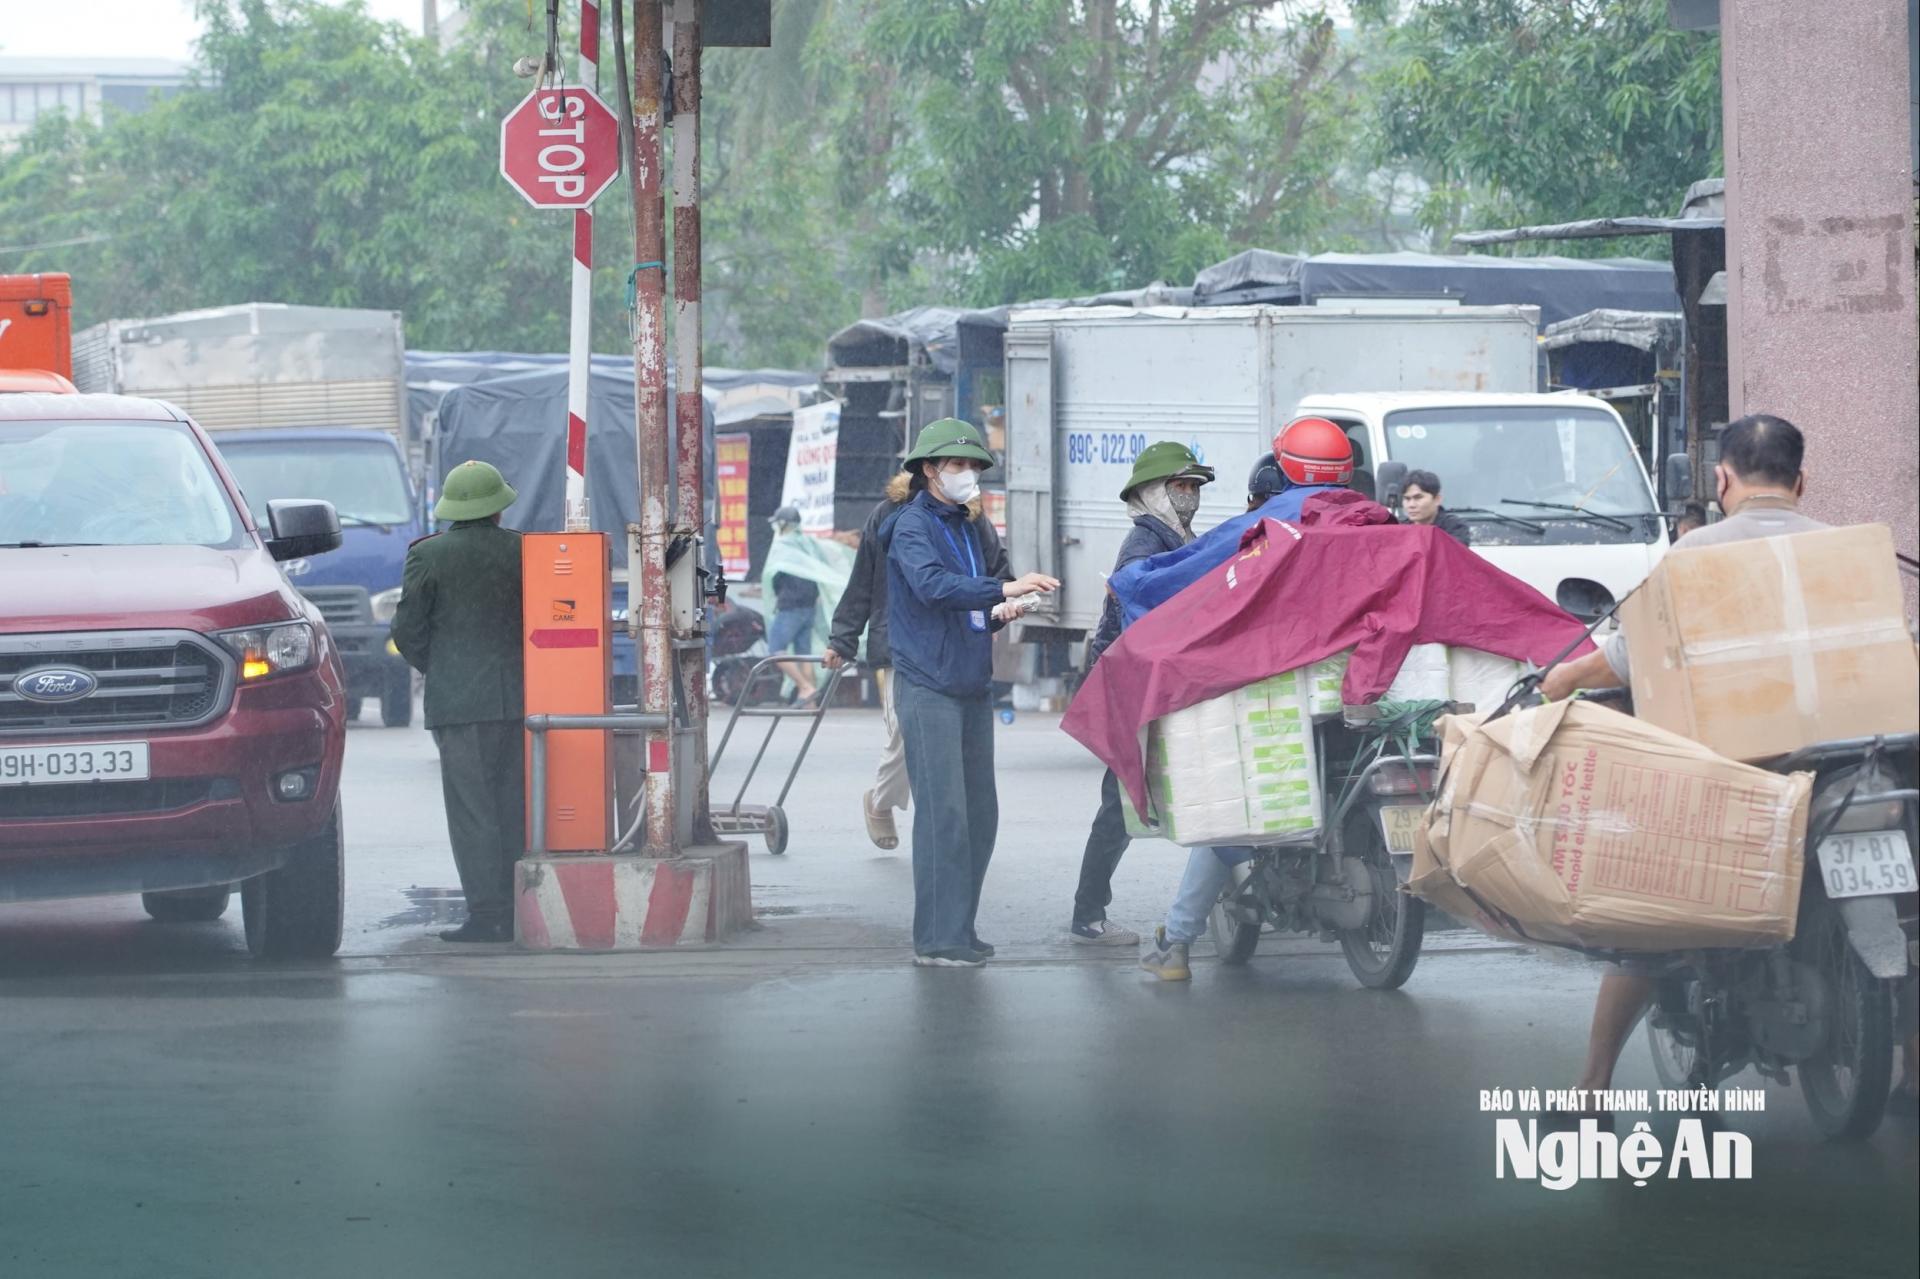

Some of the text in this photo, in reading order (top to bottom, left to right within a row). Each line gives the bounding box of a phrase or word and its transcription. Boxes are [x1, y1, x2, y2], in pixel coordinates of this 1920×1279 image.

[538, 96, 585, 197] STOP
[553, 614, 576, 622] CAME
[35, 675, 77, 694] Ford
[0, 750, 133, 779] 9H-033.33
[1580, 747, 1598, 791] kettle
[1830, 836, 1895, 864] 37-B1
[1829, 863, 1910, 892] 034.59
